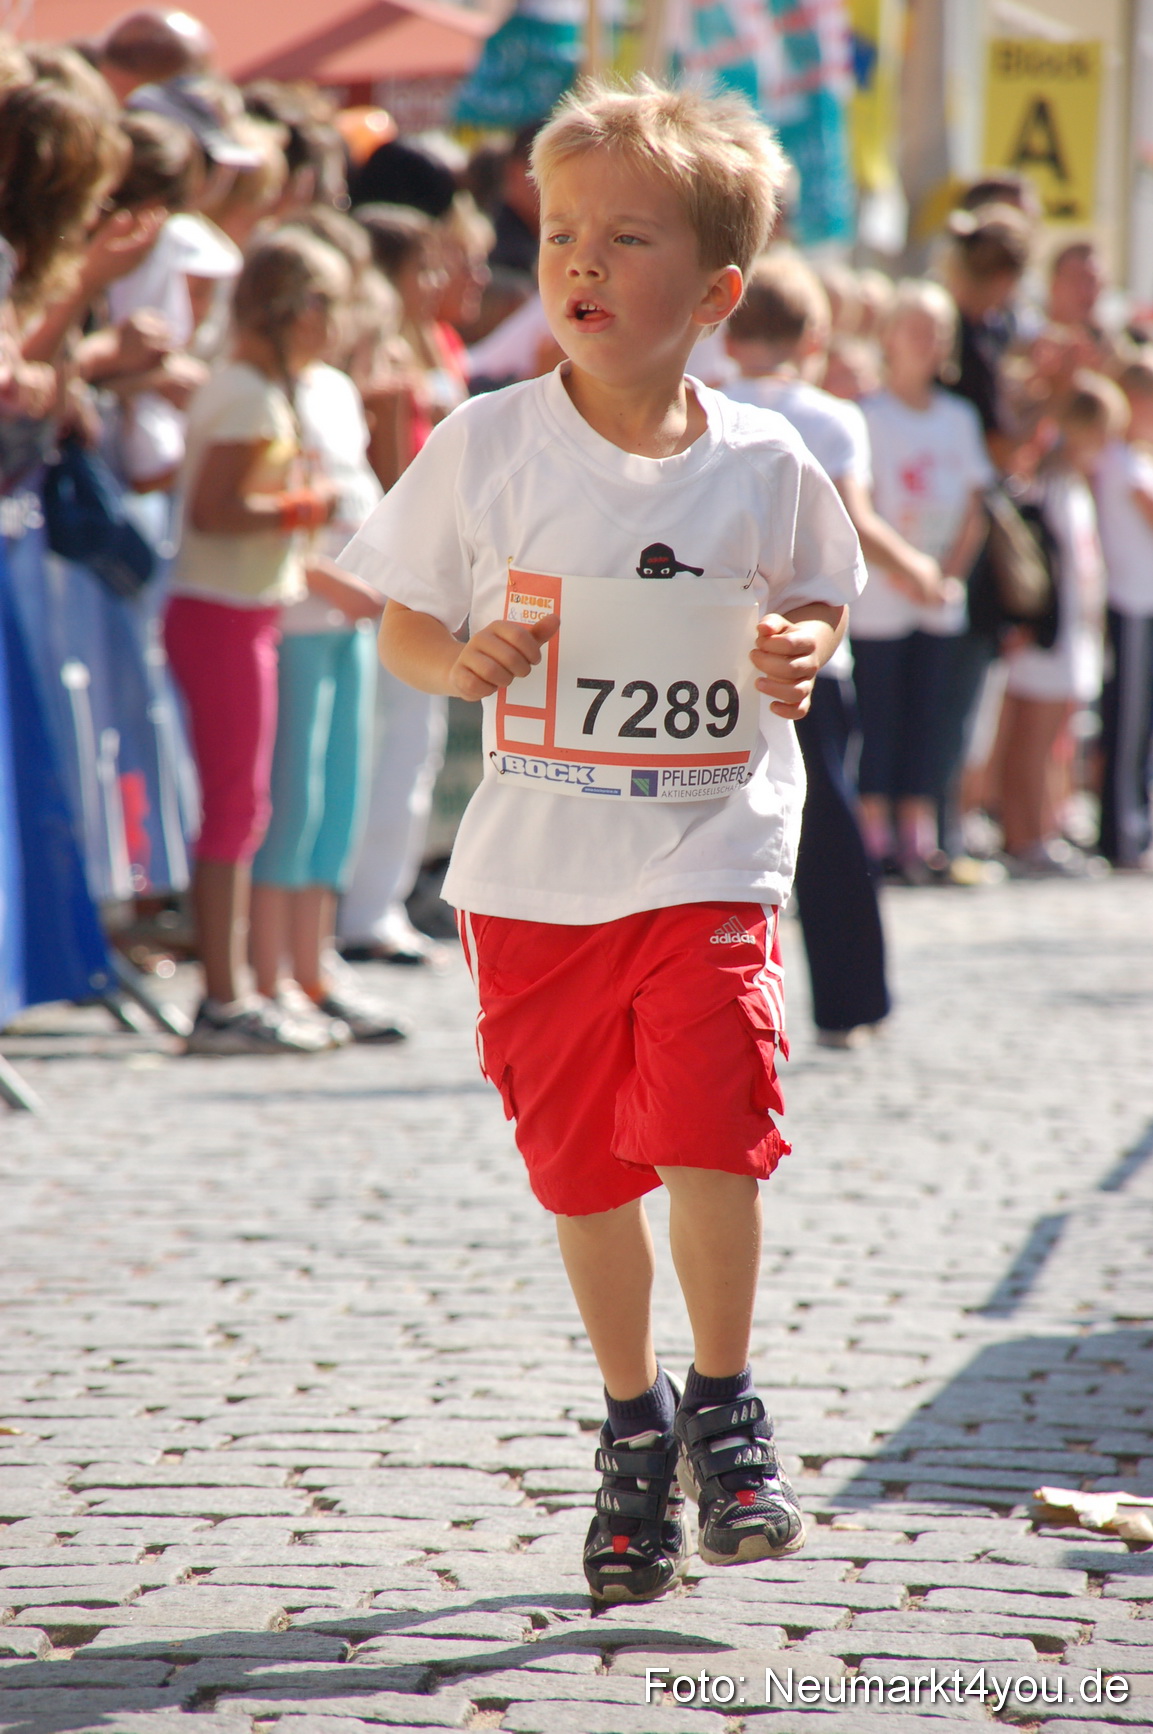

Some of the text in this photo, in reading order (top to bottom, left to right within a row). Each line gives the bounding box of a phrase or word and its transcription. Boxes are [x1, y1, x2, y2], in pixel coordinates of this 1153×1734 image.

[1009, 95, 1073, 184] A
[576, 677, 740, 739] 7289
[502, 755, 595, 785] BOCK
[662, 765, 746, 787] PFLEIDERER
[709, 933, 756, 945] adidas
